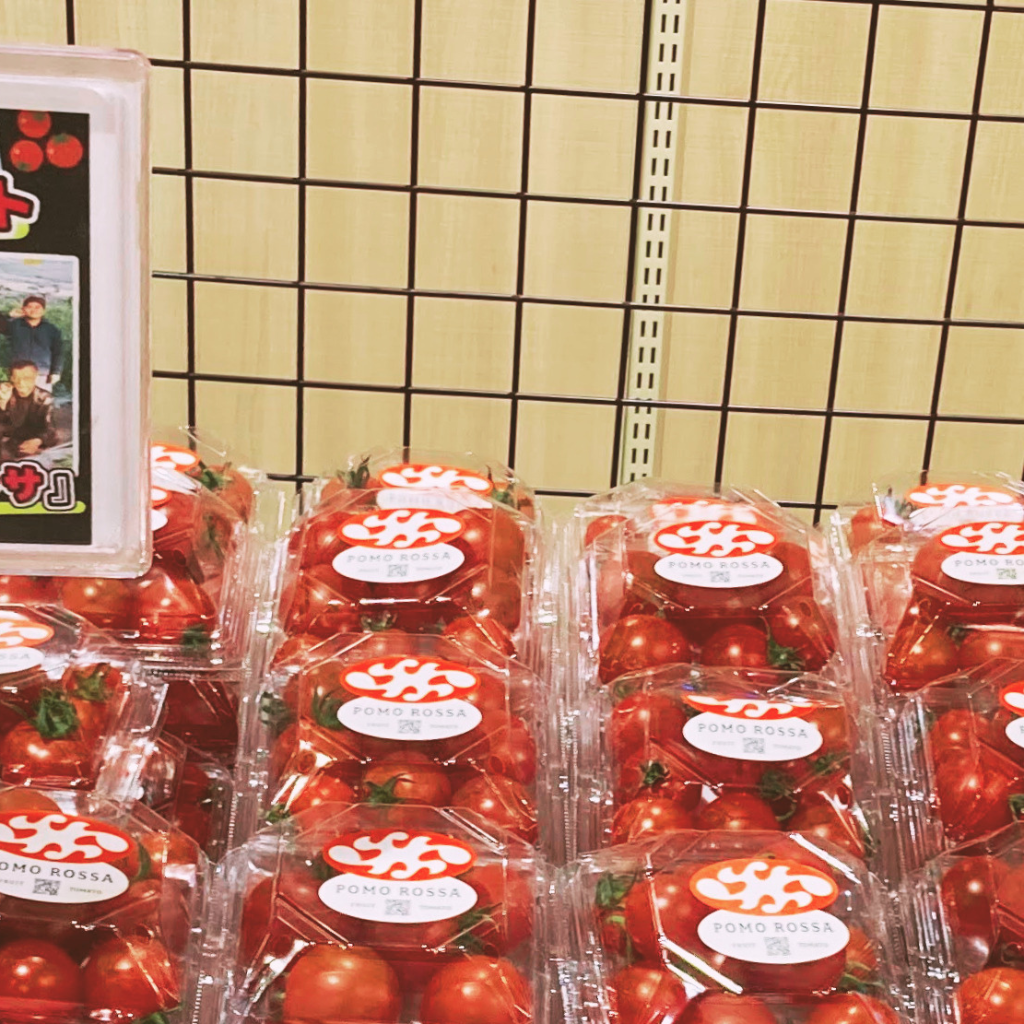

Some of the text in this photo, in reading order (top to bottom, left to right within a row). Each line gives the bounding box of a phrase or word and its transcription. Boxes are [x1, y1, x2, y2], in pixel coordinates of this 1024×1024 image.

[346, 552, 450, 563] POMO ROSSA
[353, 707, 466, 717] POMO ROSSA
[698, 724, 808, 738] POMO ROSSA
[50, 867, 113, 883] ROSSA
[336, 885, 460, 898] POMO ROSSA
[713, 922, 834, 933] POMO ROSSA
